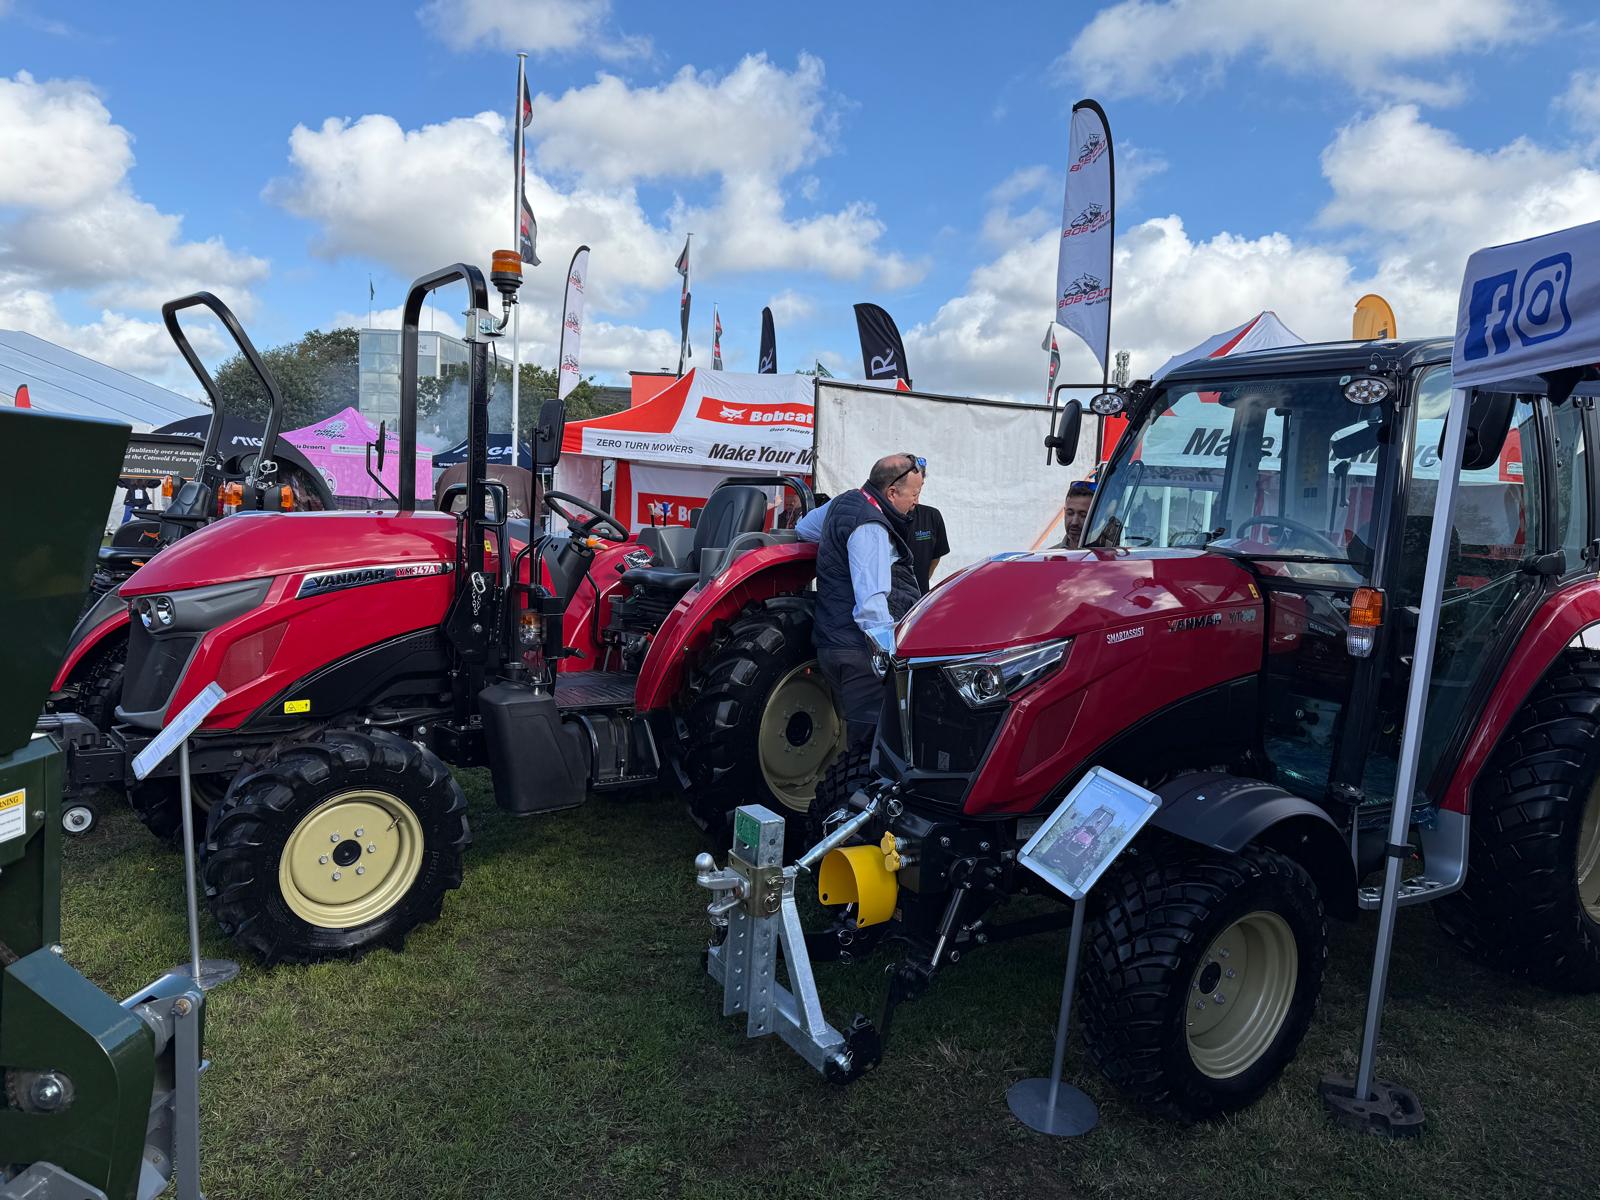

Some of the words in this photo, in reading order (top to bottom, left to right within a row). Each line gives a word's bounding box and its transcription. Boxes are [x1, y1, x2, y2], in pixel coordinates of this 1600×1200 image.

[749, 410, 814, 424] Bobcat
[128, 446, 159, 455] faultlessly
[596, 439, 622, 448] ZERO
[624, 441, 650, 450] TURN
[651, 443, 694, 454] MOWERS
[1182, 427, 1276, 458] Mae
[708, 443, 756, 461] Make
[757, 446, 797, 464] Your
[123, 466, 151, 474] Facilities
[151, 468, 180, 476] Manager
[314, 568, 386, 588] YANMAR
[1167, 612, 1222, 633] YANMAR
[1106, 626, 1145, 645] SMARTASSIST
